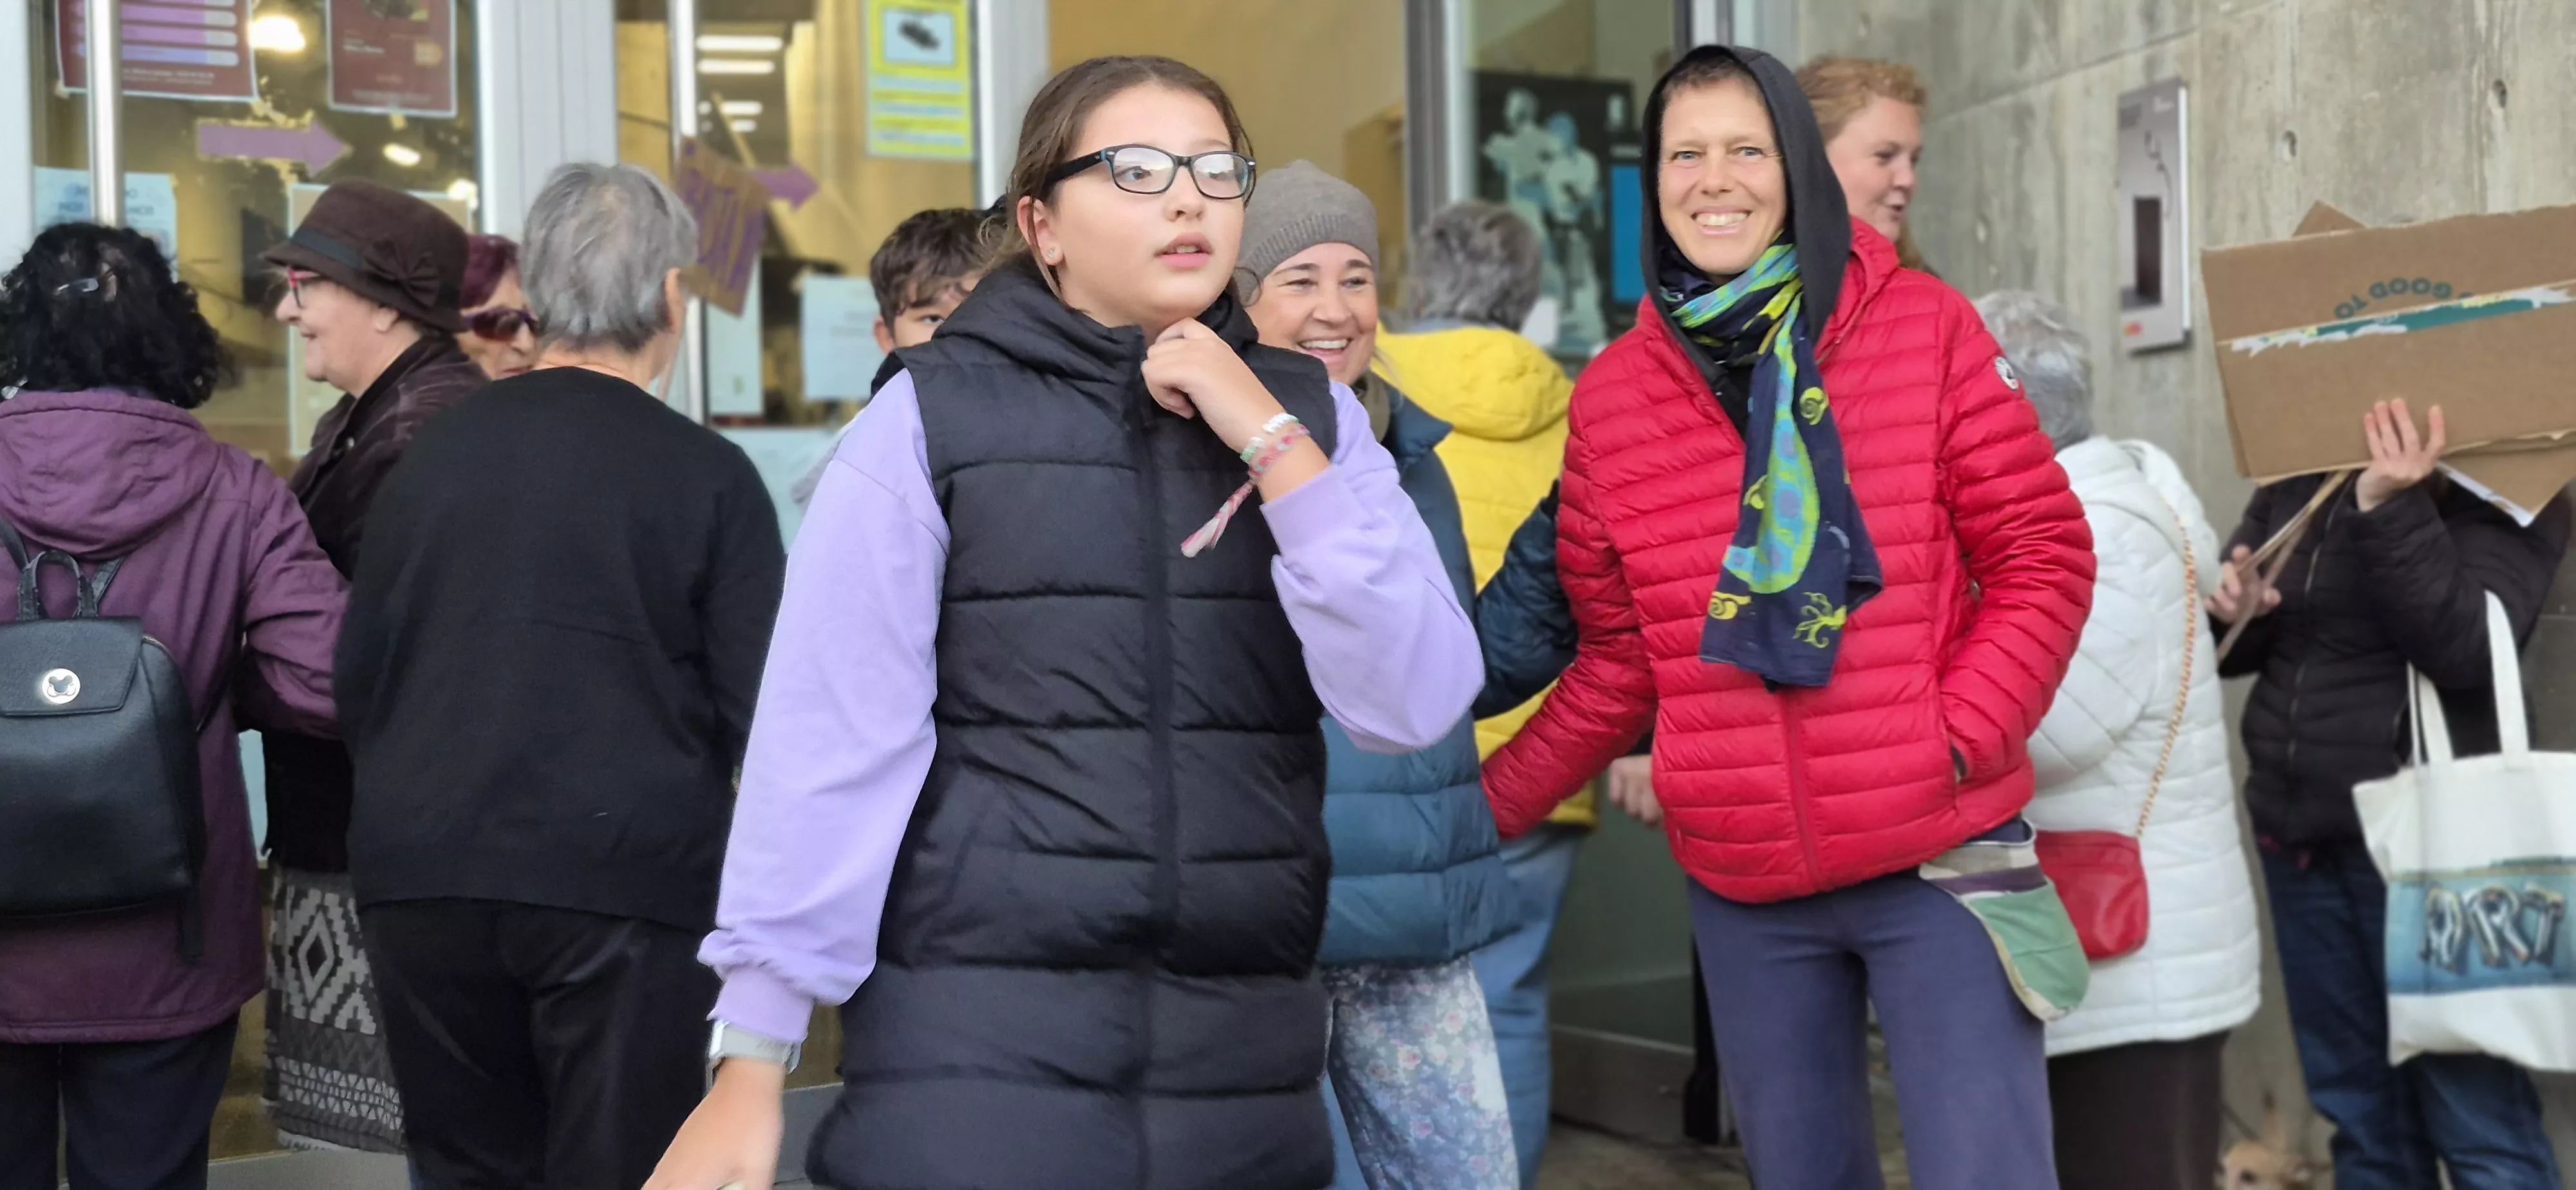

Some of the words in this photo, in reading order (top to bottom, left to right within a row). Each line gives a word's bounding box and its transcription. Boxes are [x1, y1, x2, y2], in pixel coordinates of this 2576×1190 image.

[2369, 277, 2452, 299] GOOD
[2334, 294, 2367, 319] TO
[2420, 882, 2564, 974] ART
